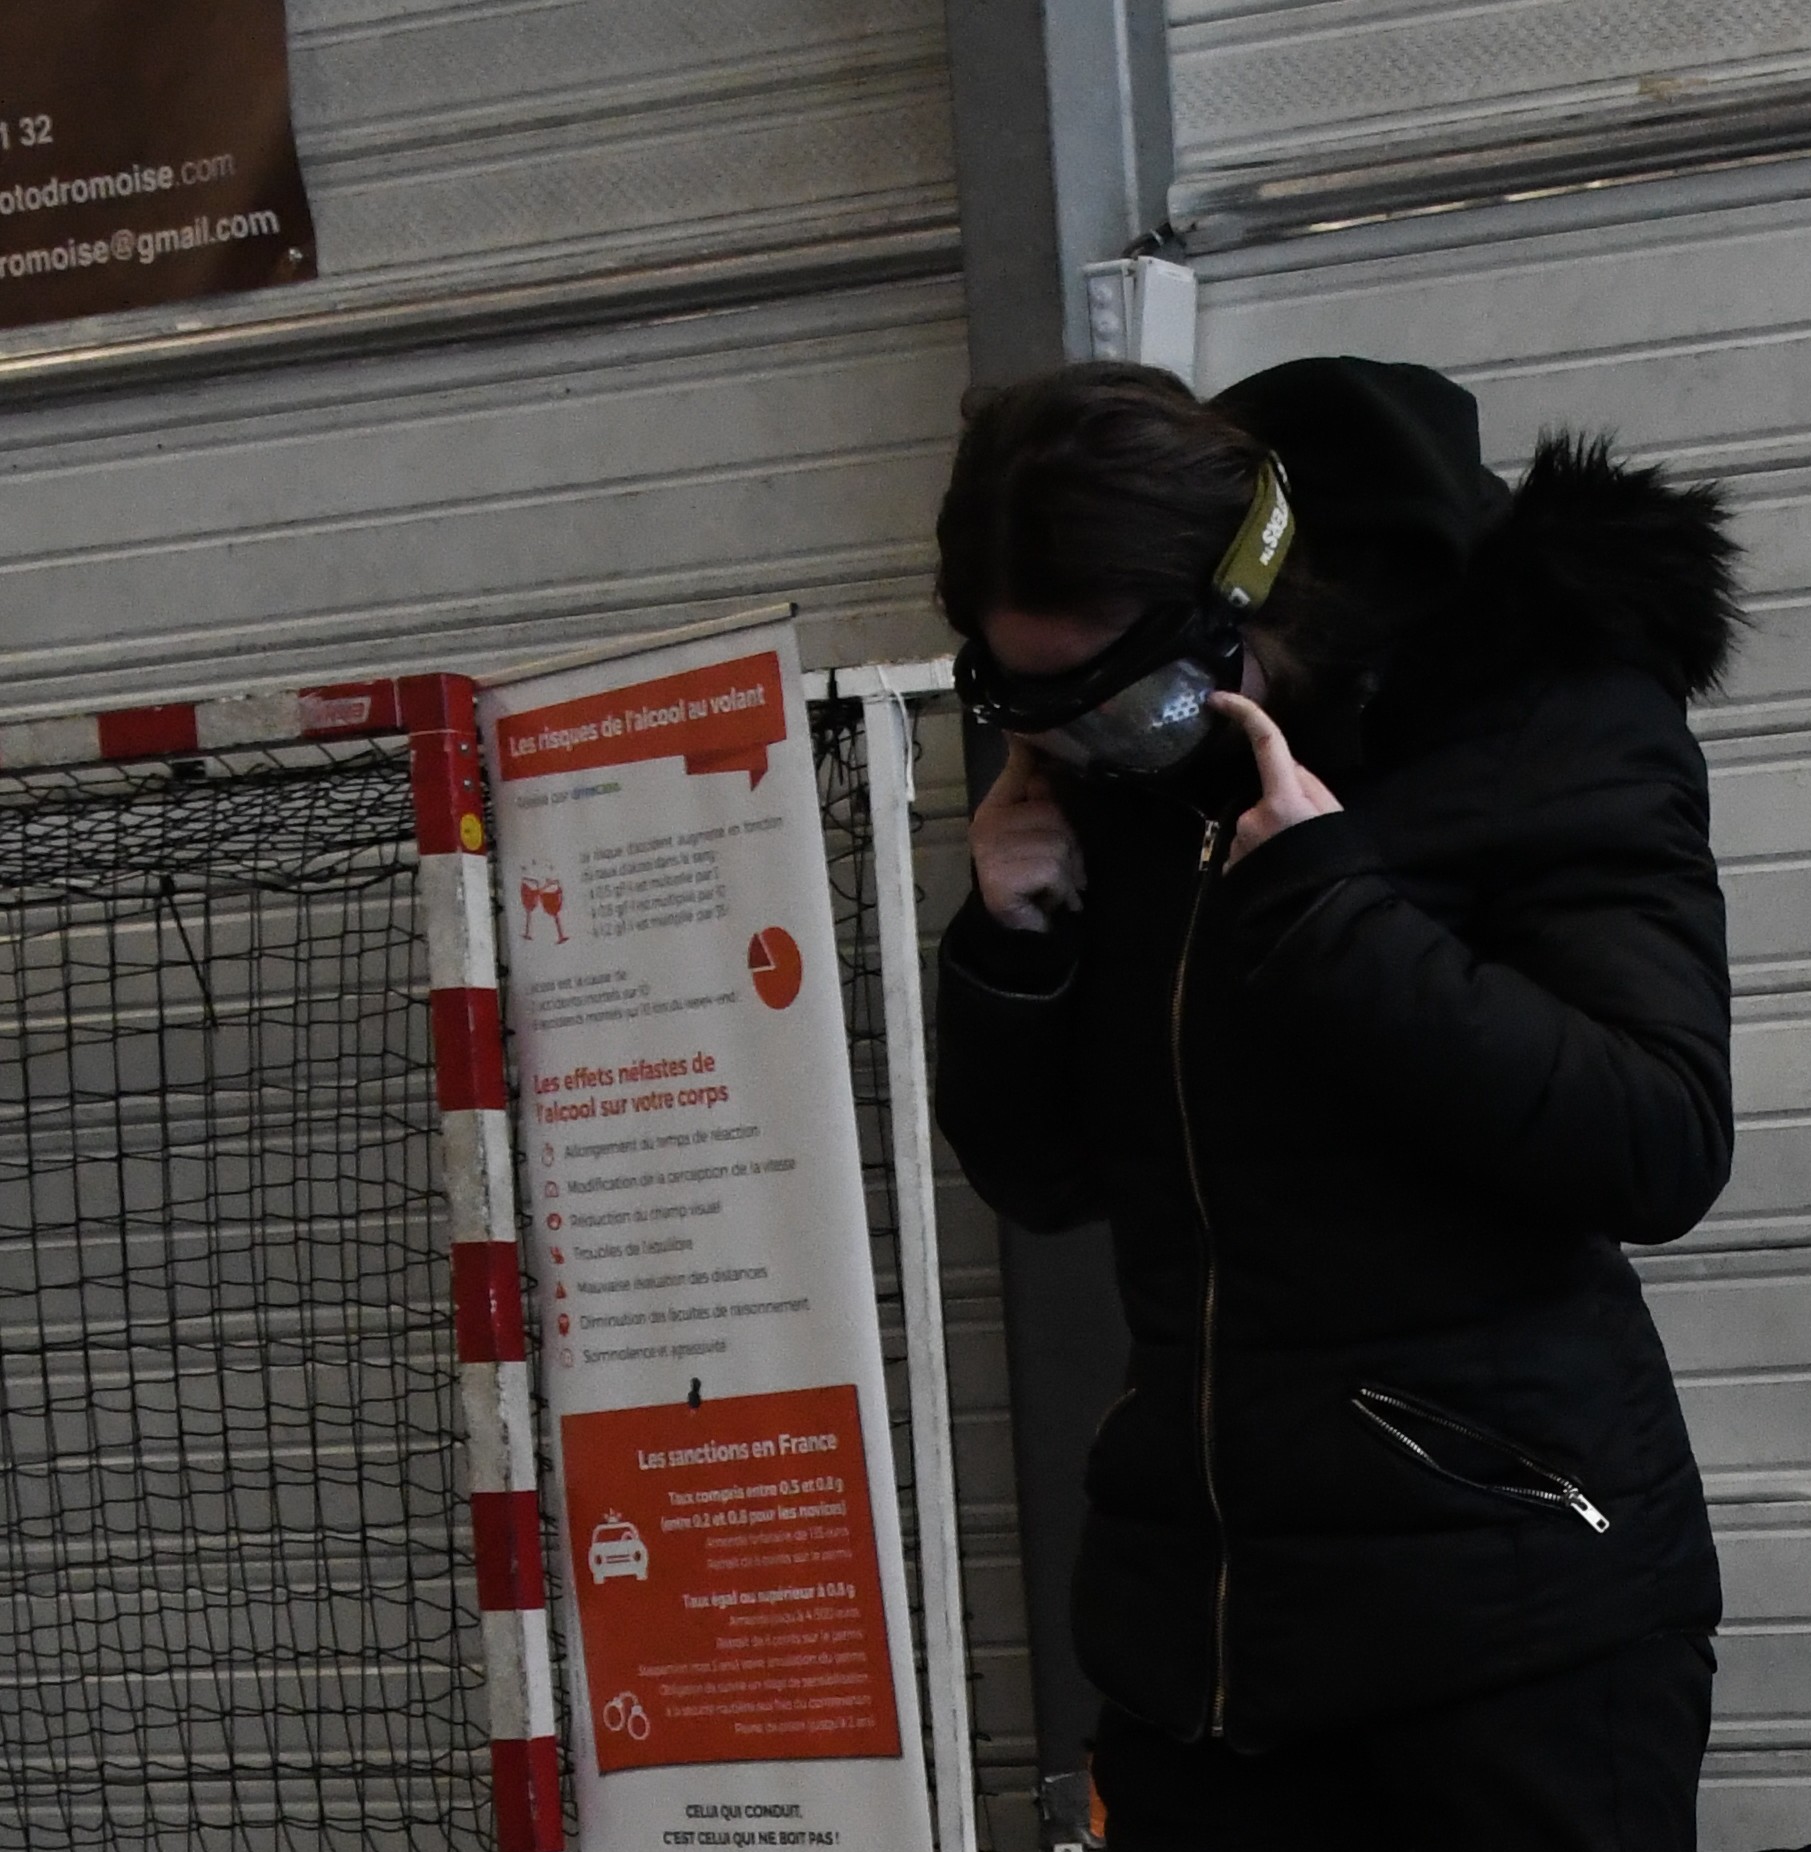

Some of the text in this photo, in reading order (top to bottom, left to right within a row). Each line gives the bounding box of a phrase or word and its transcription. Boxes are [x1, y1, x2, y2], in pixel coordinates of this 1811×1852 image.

[19, 114, 53, 146] 32
[0, 154, 237, 215] otodromoise.com
[0, 209, 279, 279] romoise@gmail.com
[509, 683, 766, 757] Les risques de l'alcool au volant
[533, 1050, 715, 1094] Les effets néfastes de
[536, 1084, 729, 1124] l'alcool sur votre corps
[638, 1433, 838, 1470] Les sanctions en France
[685, 1804, 719, 1818] CELUI
[720, 1804, 742, 1821] QUI
[663, 1831, 695, 1845] C'EST
[697, 1831, 731, 1845] CELUI
[732, 1831, 755, 1848] QUI
[758, 1831, 777, 1845] NE
[779, 1831, 806, 1845] BOIT
